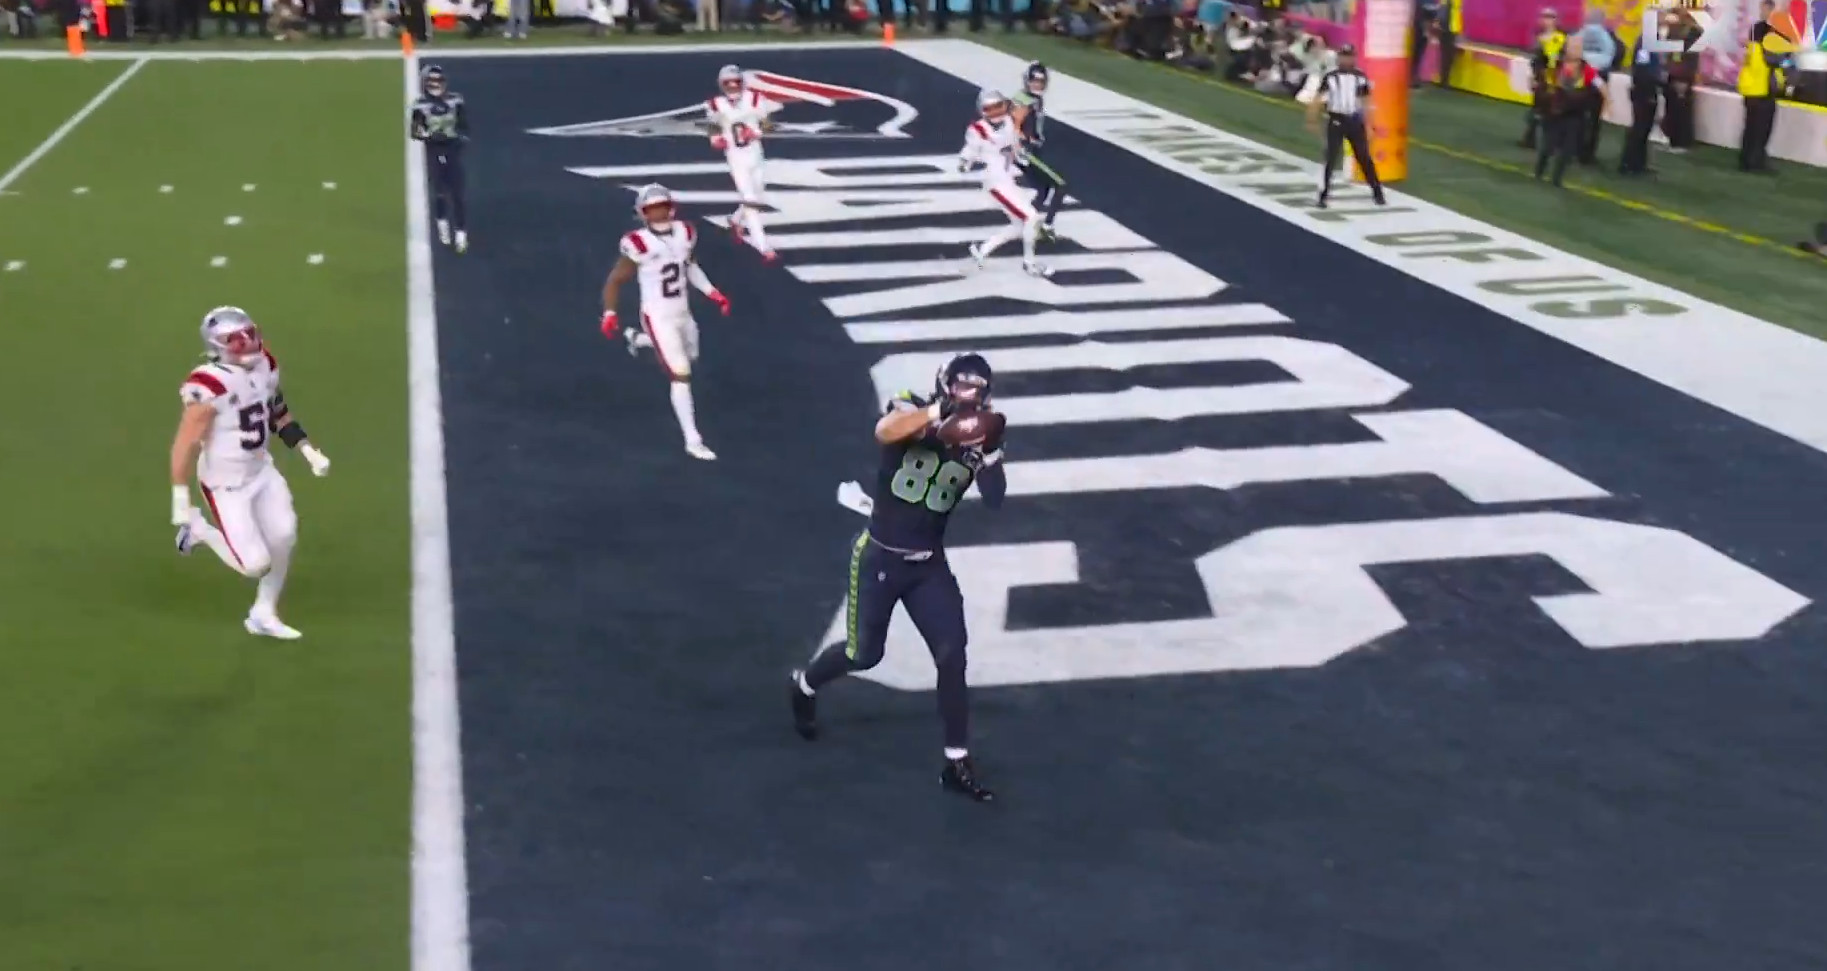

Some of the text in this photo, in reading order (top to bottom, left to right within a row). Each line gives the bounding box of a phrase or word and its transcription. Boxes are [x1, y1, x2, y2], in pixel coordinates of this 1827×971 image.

[661, 260, 689, 298] 2
[1060, 107, 1690, 319] IT TAKES ALL OF US
[563, 153, 1813, 692] PATRIOTS
[891, 448, 973, 513] 88
